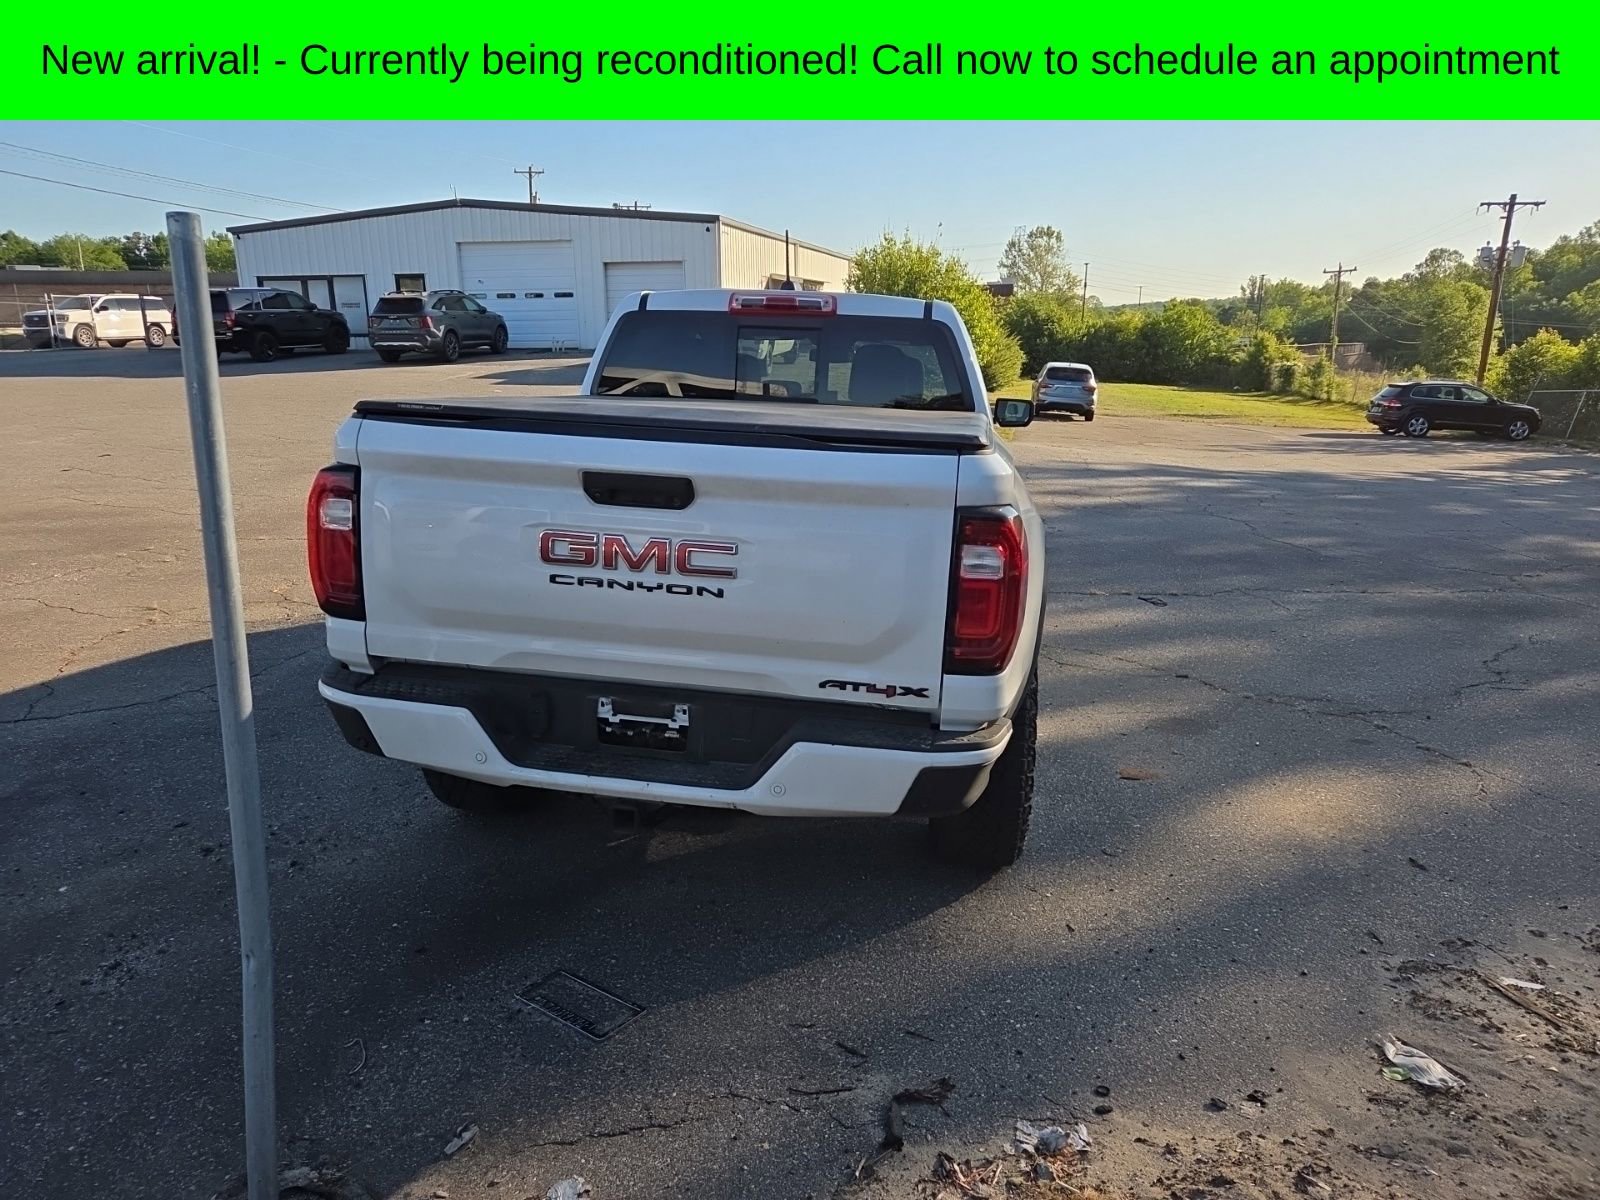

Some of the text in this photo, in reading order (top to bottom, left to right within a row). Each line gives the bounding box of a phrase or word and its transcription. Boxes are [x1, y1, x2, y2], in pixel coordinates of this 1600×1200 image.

[539, 529, 738, 579] GMC
[549, 574, 724, 598] CANYON
[819, 680, 929, 698] AT4X
